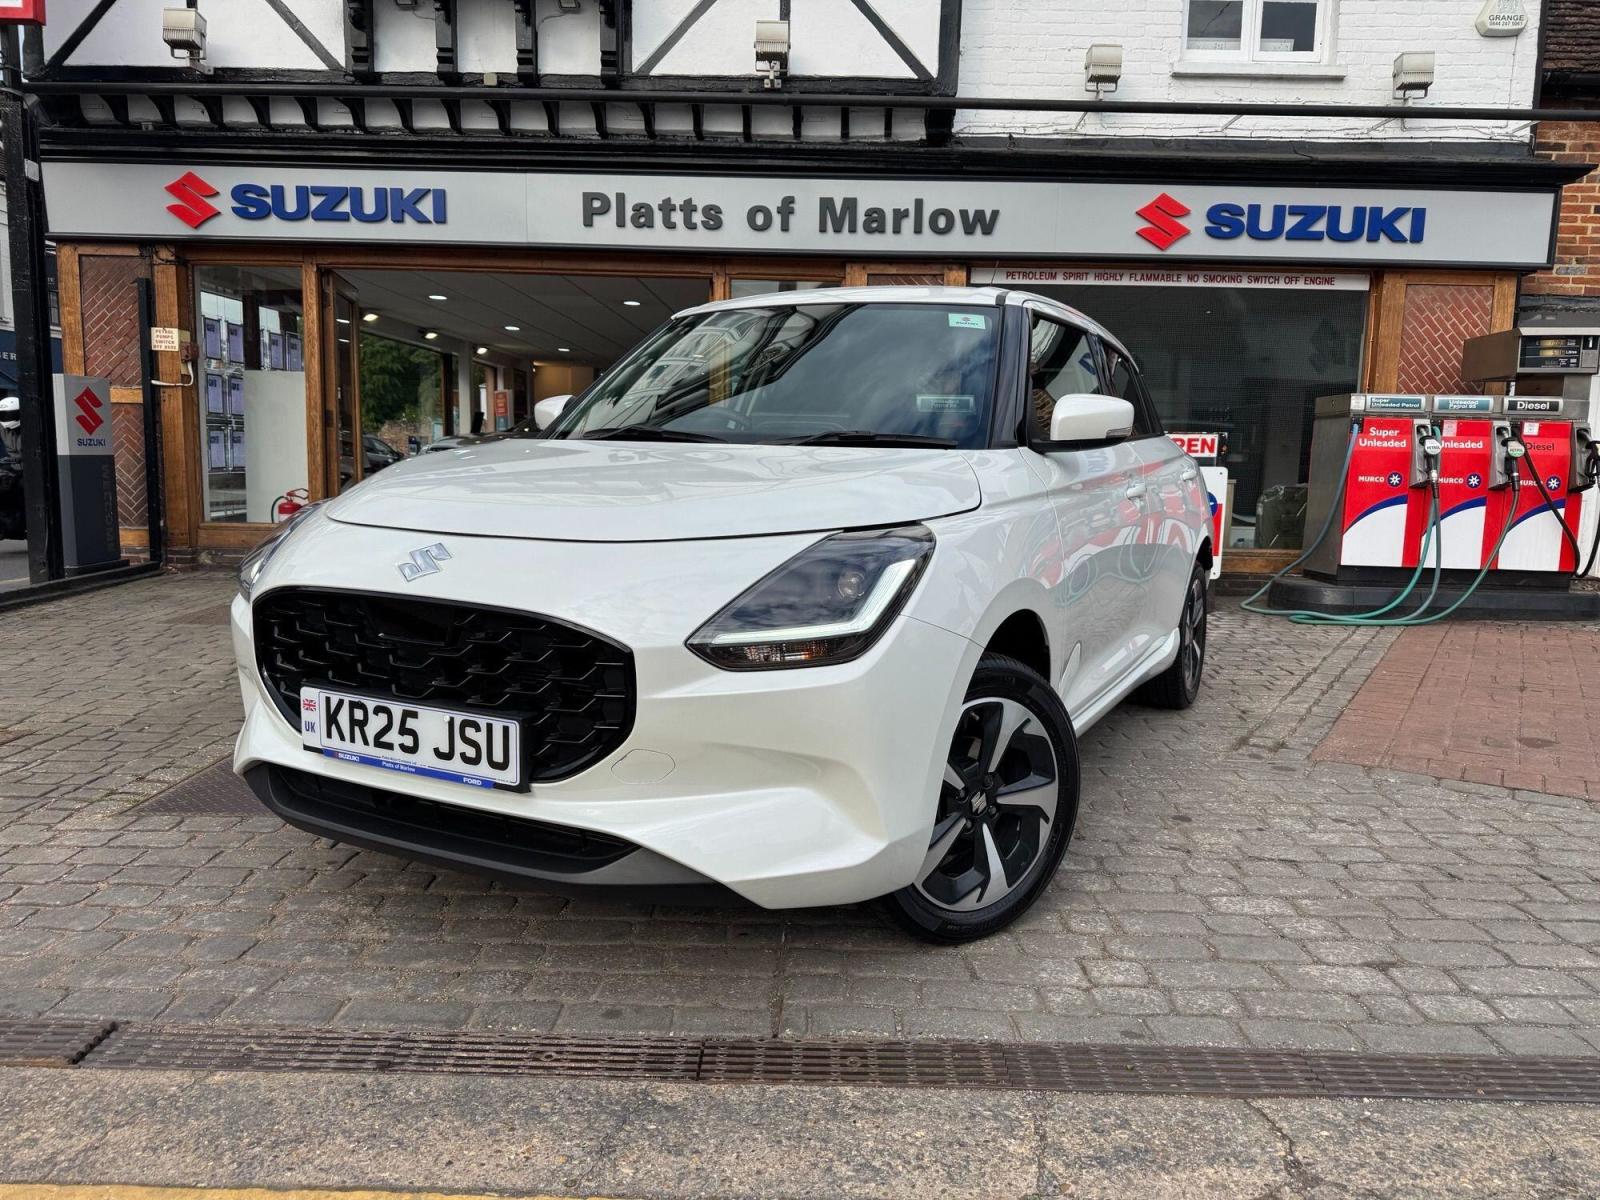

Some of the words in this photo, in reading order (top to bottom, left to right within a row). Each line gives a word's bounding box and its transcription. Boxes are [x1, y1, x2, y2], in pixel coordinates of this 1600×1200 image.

[231, 184, 447, 224] SUZUKI
[582, 192, 723, 231] Platts
[746, 196, 795, 231] of
[818, 197, 1000, 236] Marlow
[1205, 203, 1426, 244] SUZUKI
[1006, 271, 1057, 281] PETROLEUM
[1063, 271, 1089, 281] SPIRIT
[1094, 272, 1124, 281] HIGHLY
[1130, 272, 1182, 283] FLAMMABLE
[1187, 274, 1200, 283] NO
[1203, 273, 1243, 284] SMOKING
[1247, 275, 1280, 284] SWITCH
[1284, 275, 1300, 285] OFF
[1304, 276, 1336, 286] ENGINE
[1588, 336, 1595, 348] 1
[0, 352, 17, 361] ER
[1517, 401, 1550, 410] Diesel
[1369, 427, 1400, 438] Super
[77, 438, 106, 447] SUZUKI
[1171, 438, 1216, 453] PEN
[1359, 438, 1407, 448] Unleaded
[1525, 442, 1555, 451] Diesel
[304, 721, 316, 733] UK
[325, 696, 420, 755] KR25
[433, 716, 510, 771] JSU
[338, 753, 360, 762] SUZUKI
[382, 761, 394, 769] Platts
[463, 777, 482, 786] FORD
